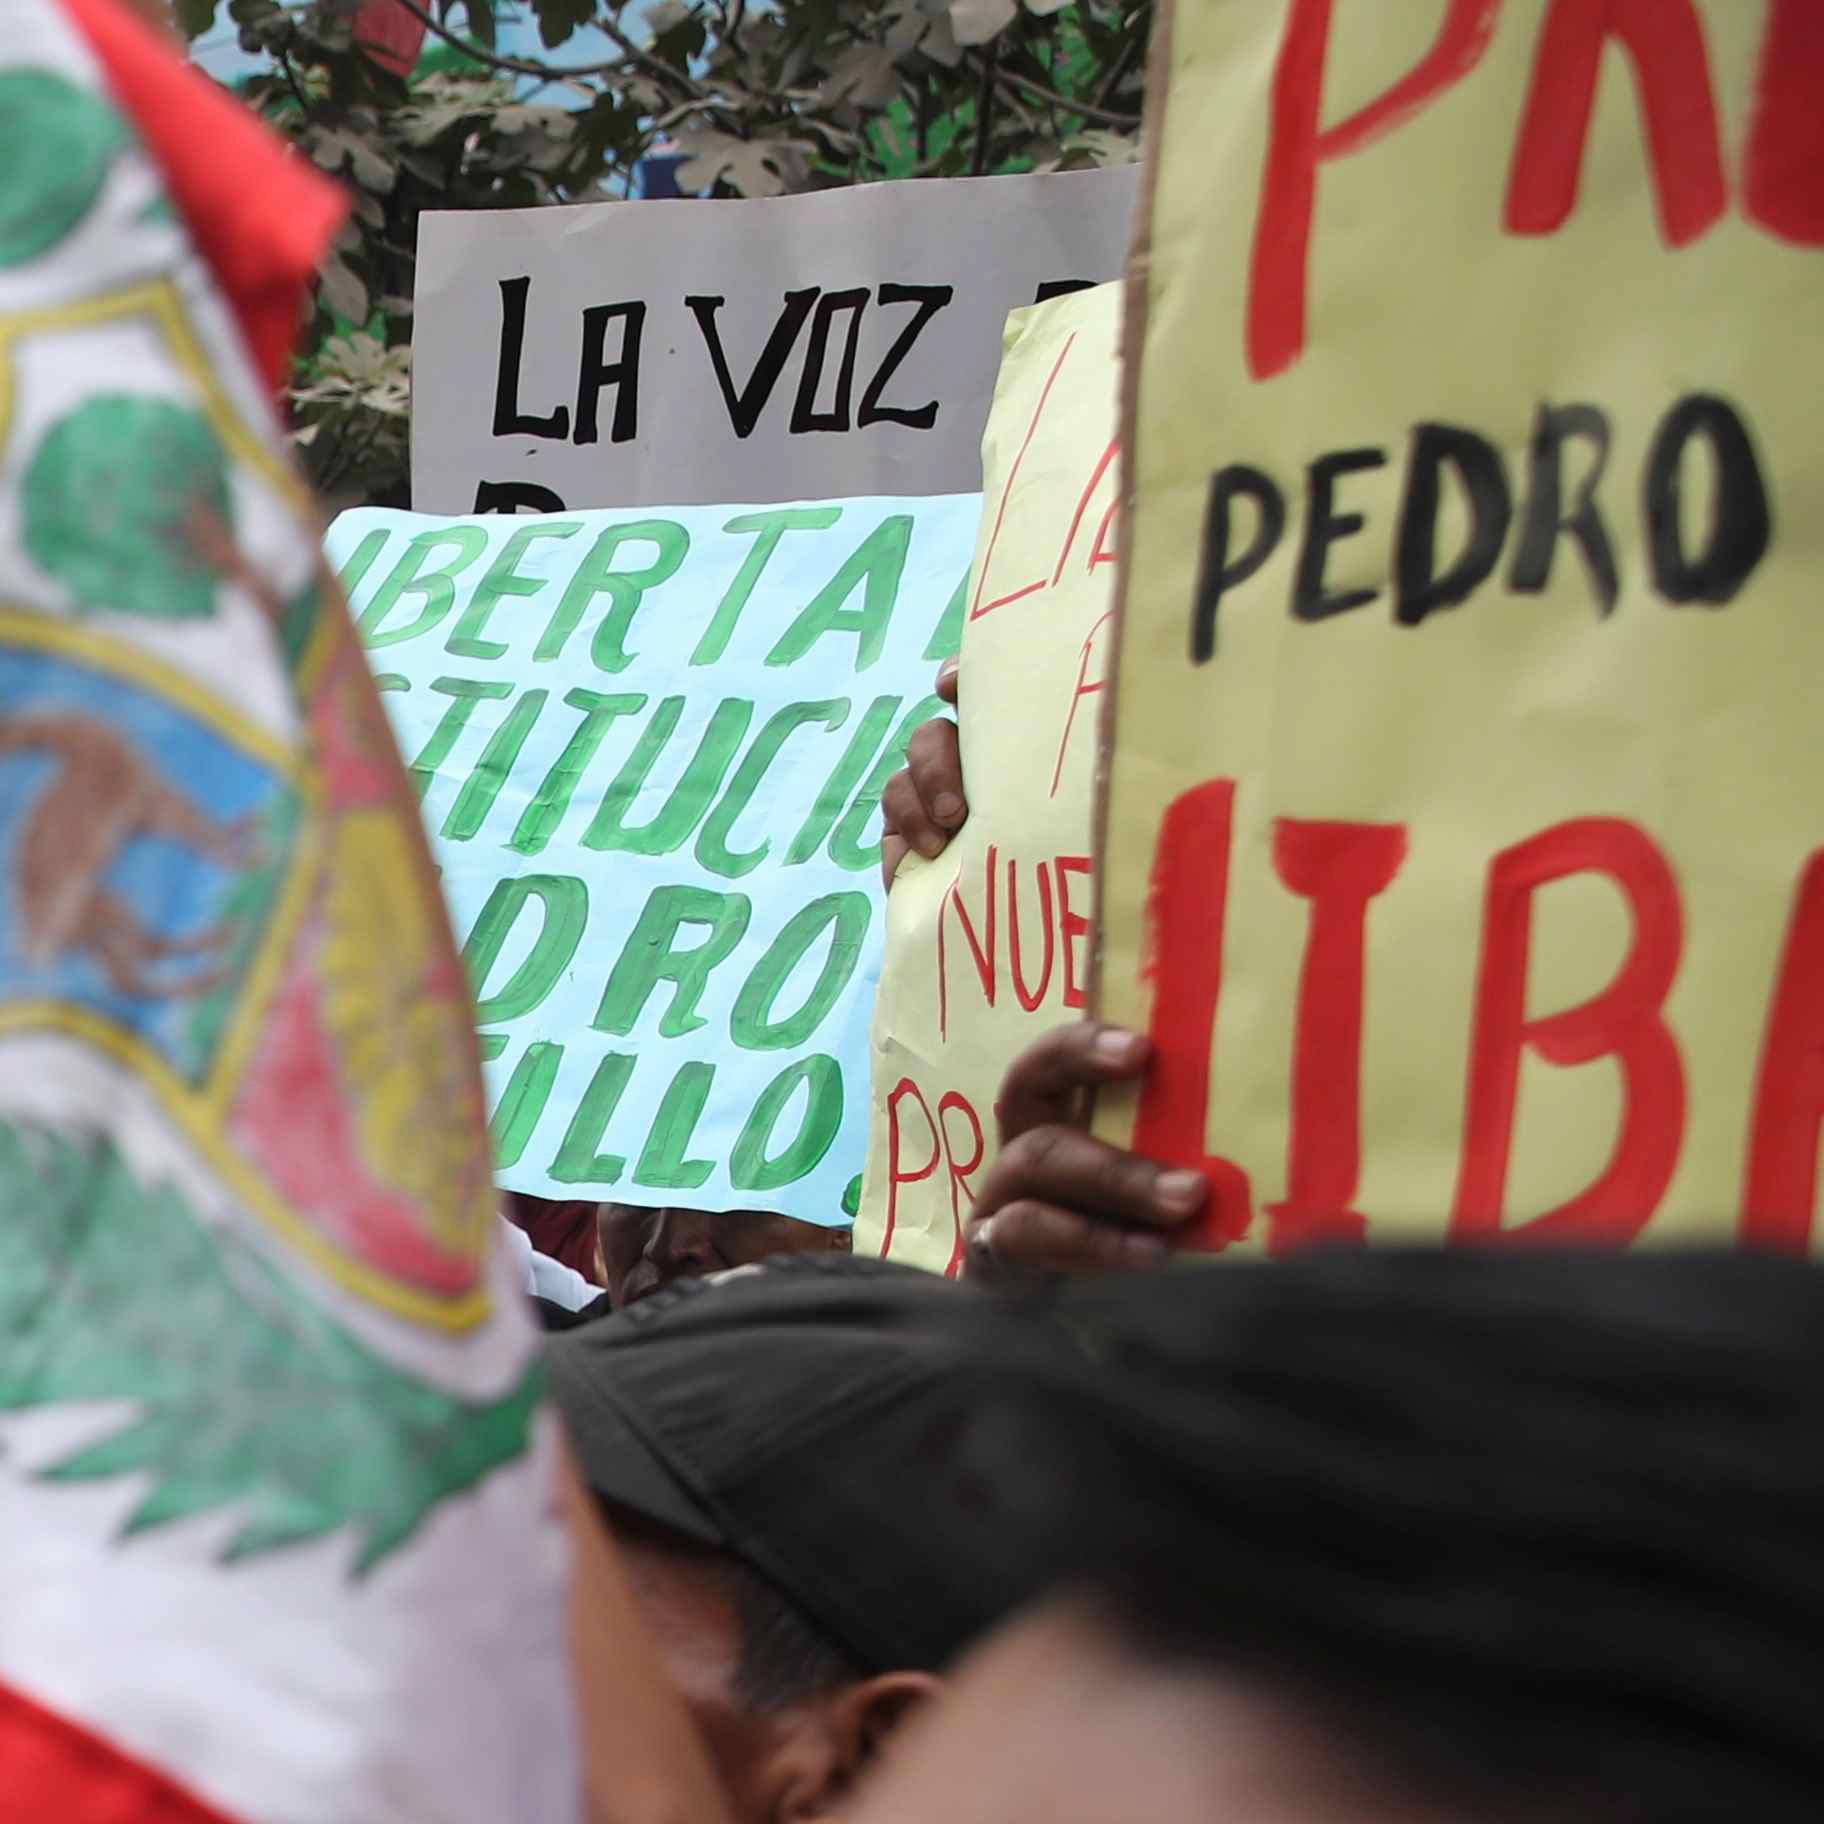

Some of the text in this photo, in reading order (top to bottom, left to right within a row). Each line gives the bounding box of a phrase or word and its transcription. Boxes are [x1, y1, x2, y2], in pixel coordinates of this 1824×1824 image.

[492, 276, 953, 444] LA VOZ
[327, 507, 972, 674] IBERTA
[1190, 393, 1772, 666] PEDRO
[437, 873, 872, 1050] DRO
[1130, 777, 1824, 1258] LIB
